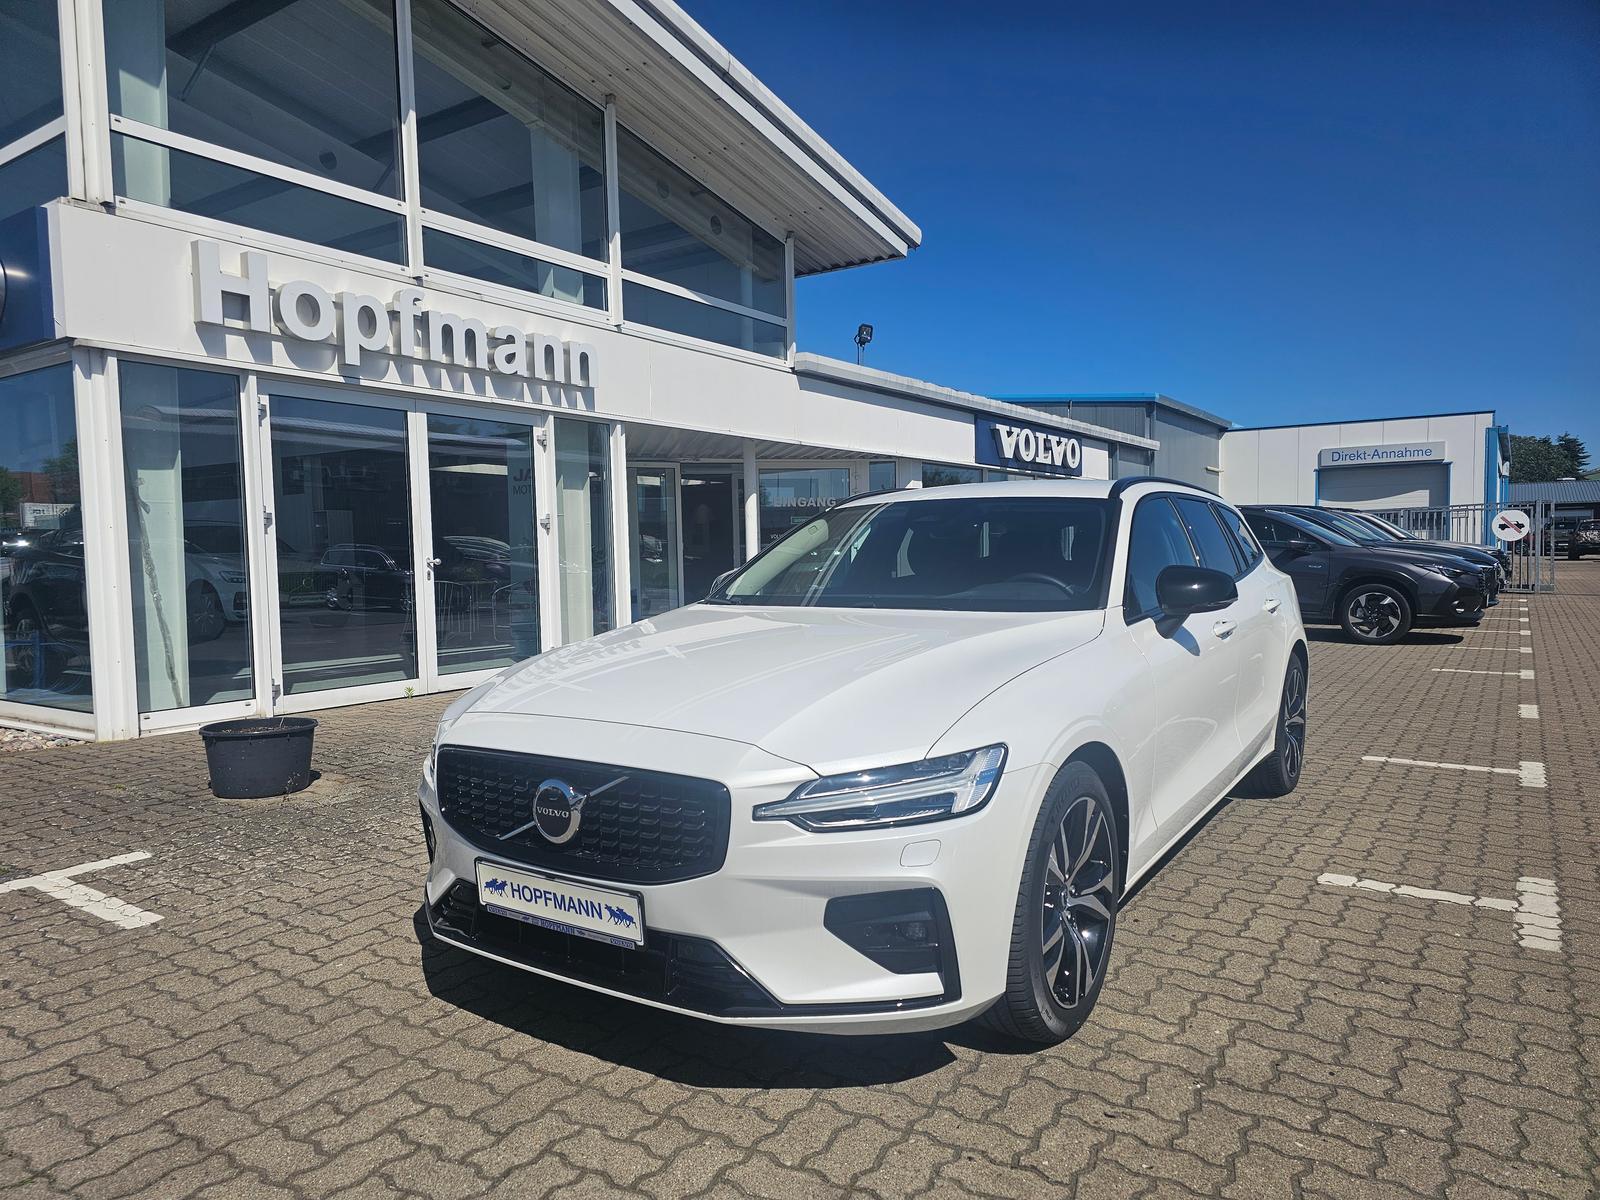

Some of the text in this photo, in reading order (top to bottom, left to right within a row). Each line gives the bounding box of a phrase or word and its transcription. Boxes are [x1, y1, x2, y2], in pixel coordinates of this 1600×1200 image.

[192, 239, 598, 389] Hopfmann
[993, 423, 1081, 469] VOLVO
[1331, 447, 1433, 462] Direkt-Annahme
[773, 496, 836, 508] EINGANG
[537, 806, 569, 818] VOLVO
[510, 882, 603, 920] HOPFMANN
